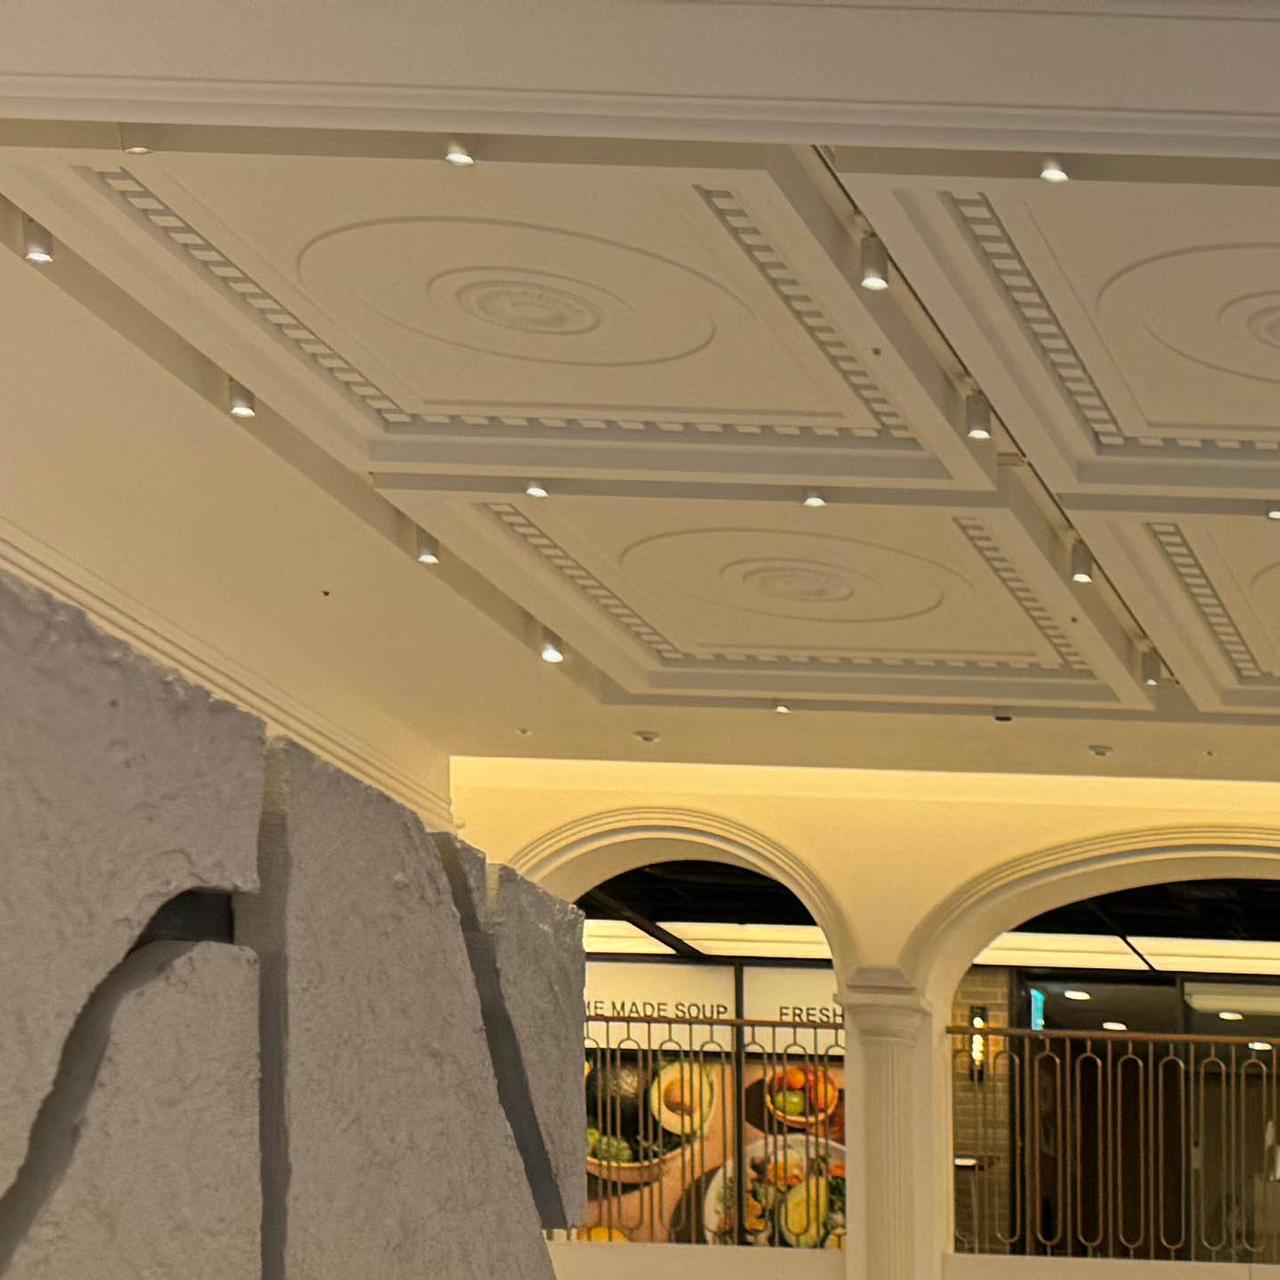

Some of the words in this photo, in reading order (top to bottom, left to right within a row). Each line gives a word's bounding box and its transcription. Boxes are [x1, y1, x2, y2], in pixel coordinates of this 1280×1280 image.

[612, 1001, 668, 1018] MADE
[675, 1003, 728, 1020] SOUP
[779, 1006, 845, 1024] FRESH
